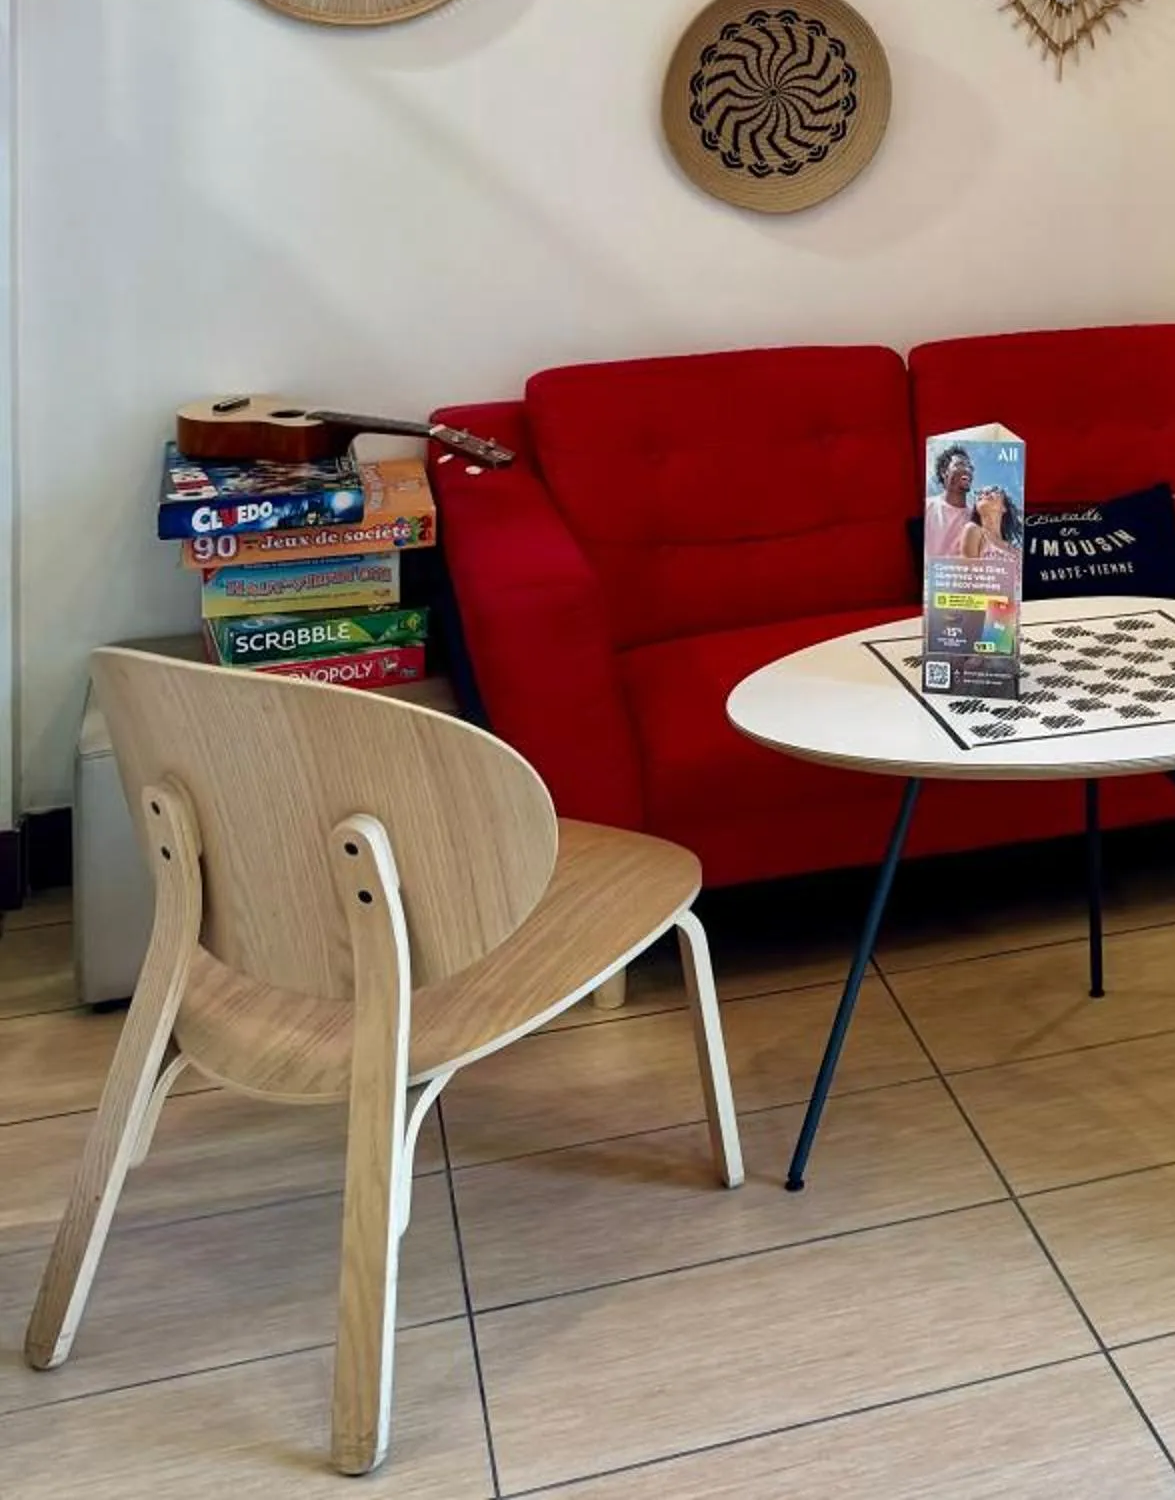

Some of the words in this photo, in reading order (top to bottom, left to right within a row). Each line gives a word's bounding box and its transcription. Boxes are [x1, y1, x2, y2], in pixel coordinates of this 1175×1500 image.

[191, 501, 273, 532] CLUEDO
[193, 533, 238, 561] 90
[260, 534, 315, 550] Jeux
[315, 529, 341, 546] de
[344, 522, 412, 542] société
[1030, 529, 1136, 557] IMOUSIN
[1040, 561, 1135, 581] HAUTE-VIENNE
[235, 622, 351, 653] SCRABBLE
[289, 660, 373, 684] NOPOLY
